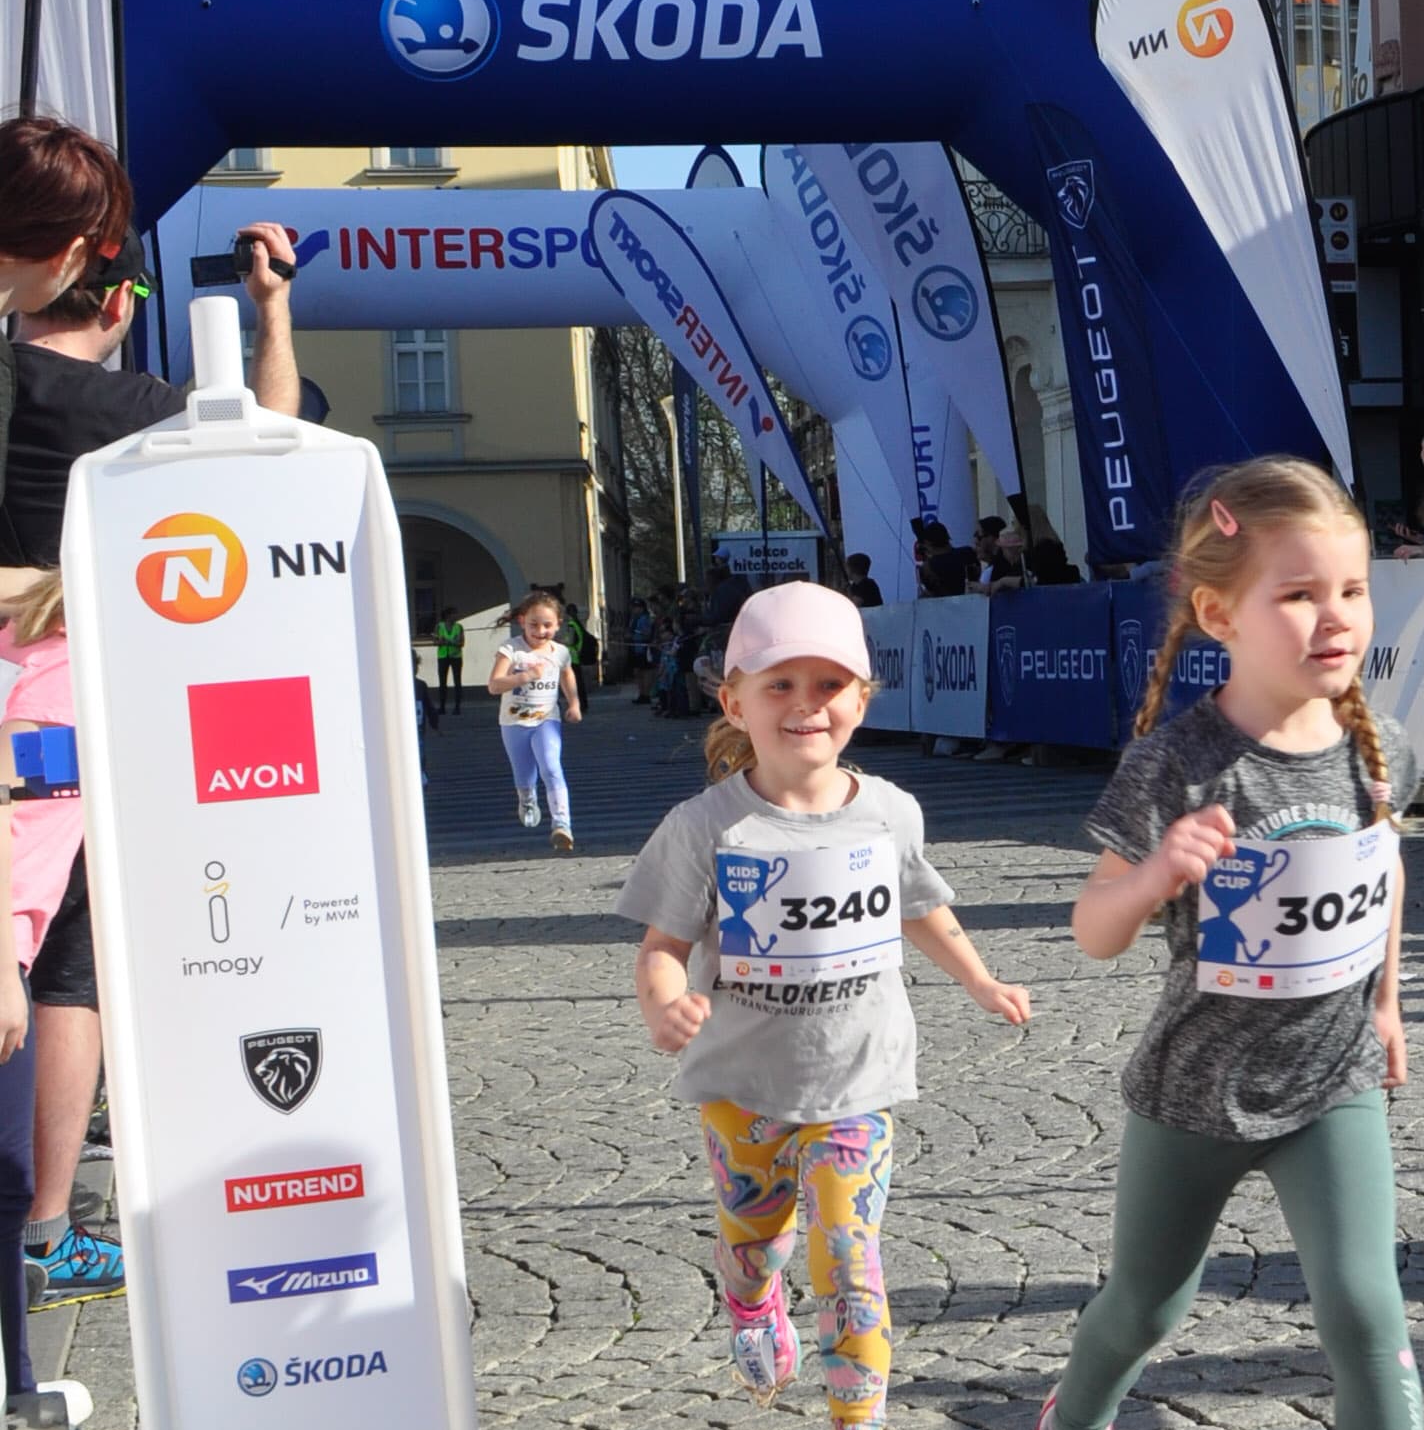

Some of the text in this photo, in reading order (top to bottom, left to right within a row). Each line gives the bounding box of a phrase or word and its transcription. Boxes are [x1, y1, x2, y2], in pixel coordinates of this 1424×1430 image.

[1072, 245, 1135, 531] PEUGEOT
[269, 539, 348, 580] NN
[750, 546, 789, 558] lekce
[733, 559, 807, 572] hitchcock
[935, 636, 978, 693] ŠKODA
[1020, 649, 1107, 680] PEUGEOT
[529, 680, 557, 691] 3065
[208, 761, 305, 793] AVON
[849, 846, 873, 860] KIDS
[726, 865, 761, 879] KIDS
[849, 859, 871, 871] CUP
[1213, 859, 1256, 873] KIDS
[727, 880, 758, 893] CUP
[1213, 876, 1252, 890] CUP
[303, 895, 360, 912] Powered
[779, 884, 892, 931] 3240
[1275, 871, 1388, 936] 3024
[304, 907, 360, 926] by MVM
[182, 955, 264, 977] innogy
[247, 1034, 314, 1050] PEUGEOT
[232, 1172, 359, 1206] NUTREND
[283, 1348, 388, 1388] ŠKODA
